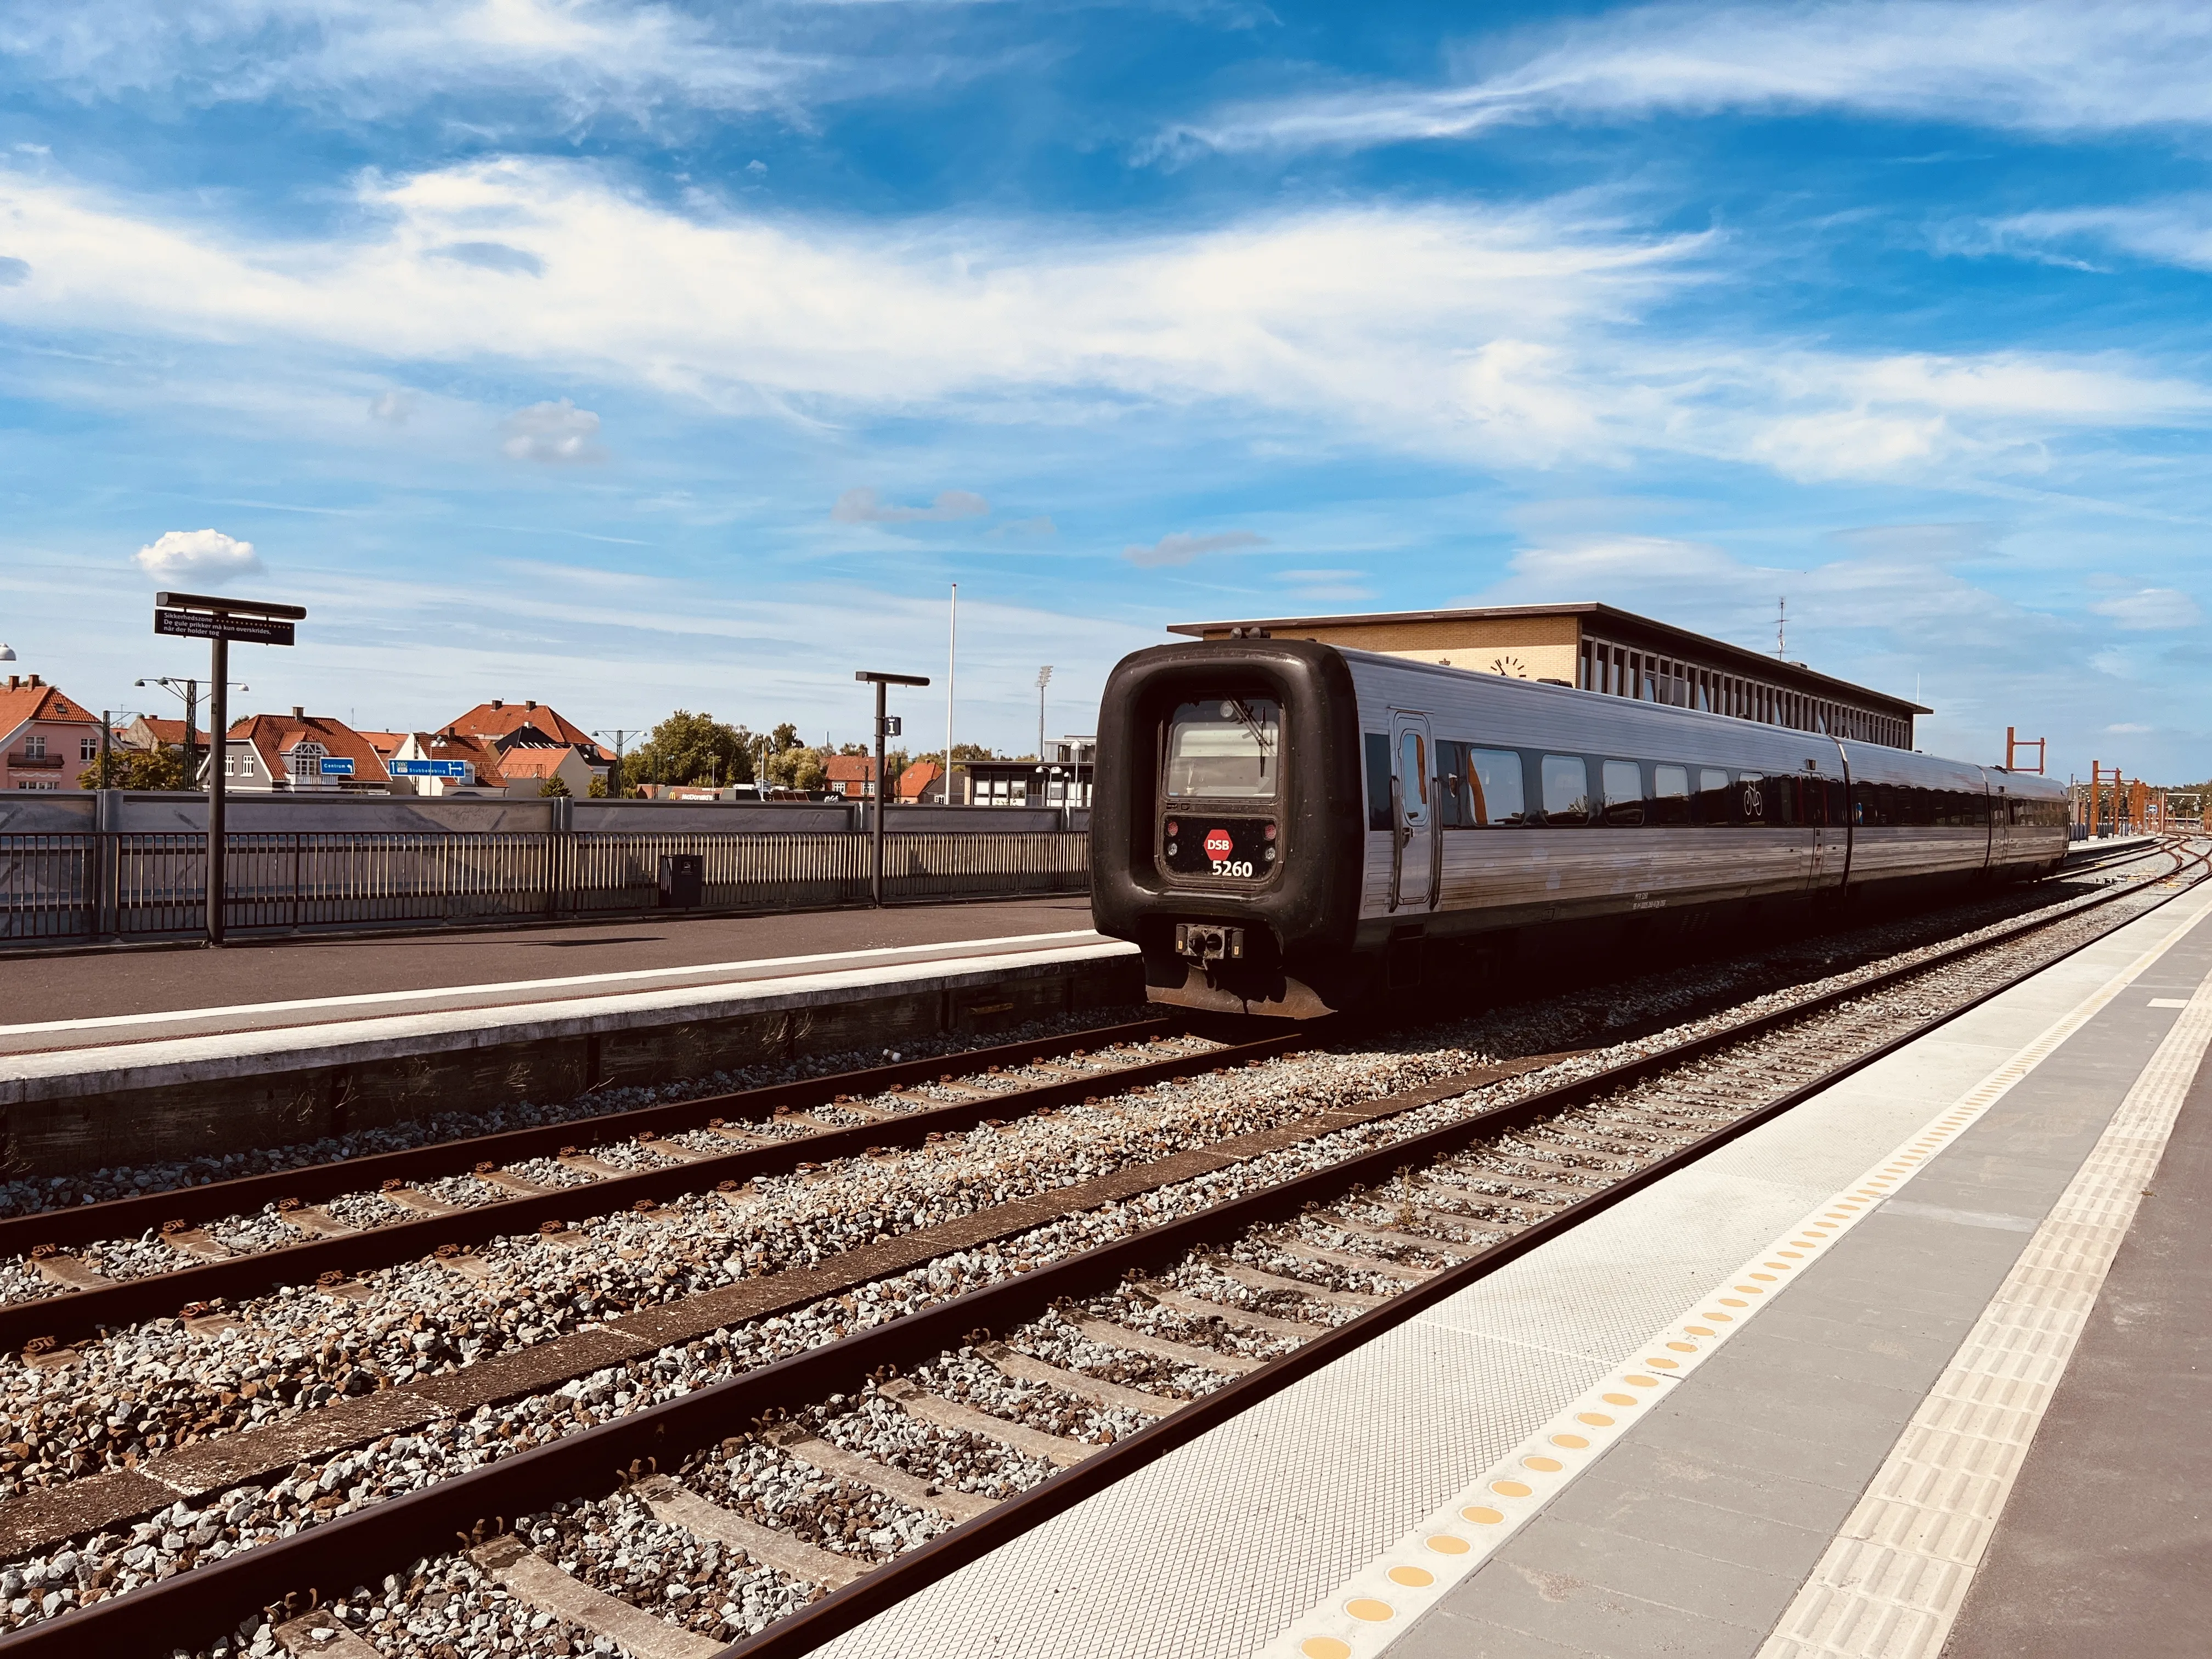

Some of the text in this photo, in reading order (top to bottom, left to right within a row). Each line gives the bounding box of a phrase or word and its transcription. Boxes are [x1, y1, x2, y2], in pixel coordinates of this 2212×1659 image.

[164, 612, 213, 623] Sikkerhedszone
[889, 723, 895, 733] 1
[1207, 839, 1229, 850] DSB
[1212, 860, 1252, 877] 5260
